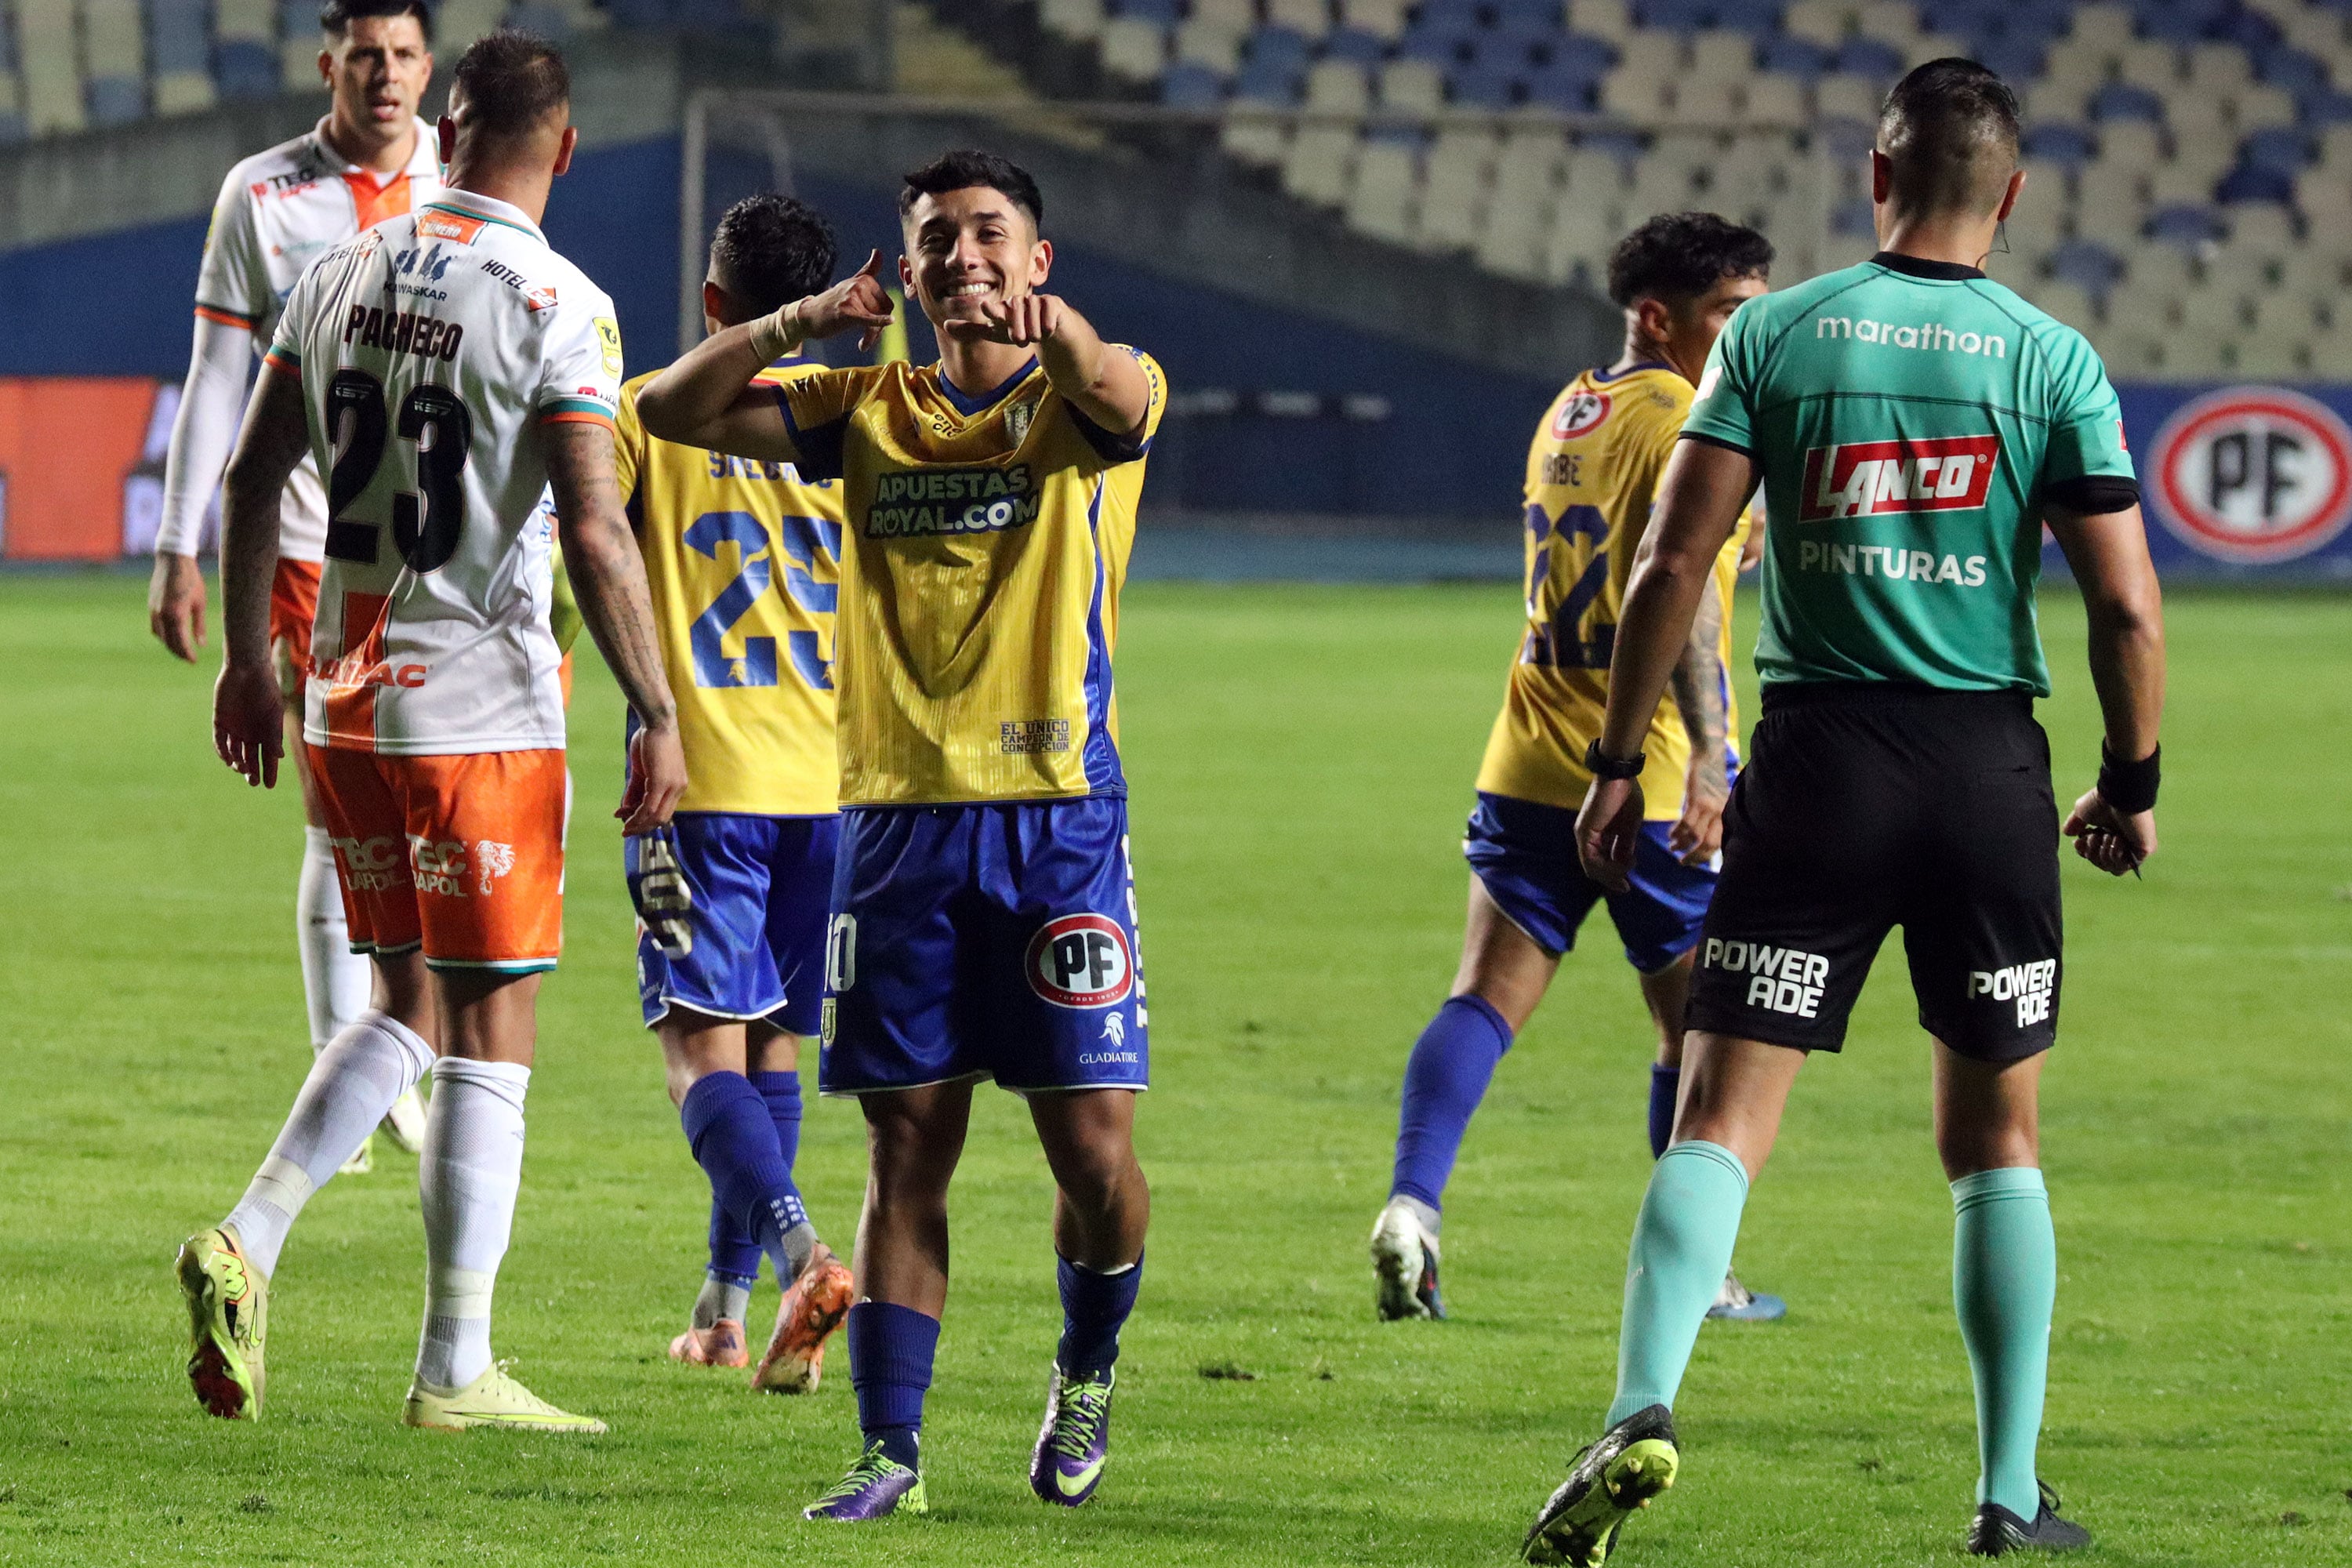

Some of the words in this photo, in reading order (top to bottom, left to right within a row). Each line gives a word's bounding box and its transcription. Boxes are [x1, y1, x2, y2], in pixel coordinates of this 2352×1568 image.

[383, 280, 448, 302] KAWASKAR
[481, 260, 528, 290] HOTEL
[343, 304, 463, 362] PACHECO
[1817, 317, 2005, 358] marathon
[324, 369, 474, 575] 23
[877, 468, 1028, 503] APUESTAS
[1817, 445, 1976, 517] LANCO
[2209, 430, 2303, 520] PF
[869, 494, 1038, 534] ROYAL.COM
[1800, 541, 1987, 587] PINTURAS
[683, 511, 841, 690] 25
[1001, 724, 1020, 735] EL
[1001, 742, 1069, 753] CONCEPCION
[1057, 733, 1069, 742] DE
[1052, 931, 1114, 989] PF
[1704, 938, 1829, 988] POWER
[1968, 958, 2056, 1000] POWER
[1747, 975, 1824, 1018] ADE
[2016, 988, 2052, 1028] ADE
